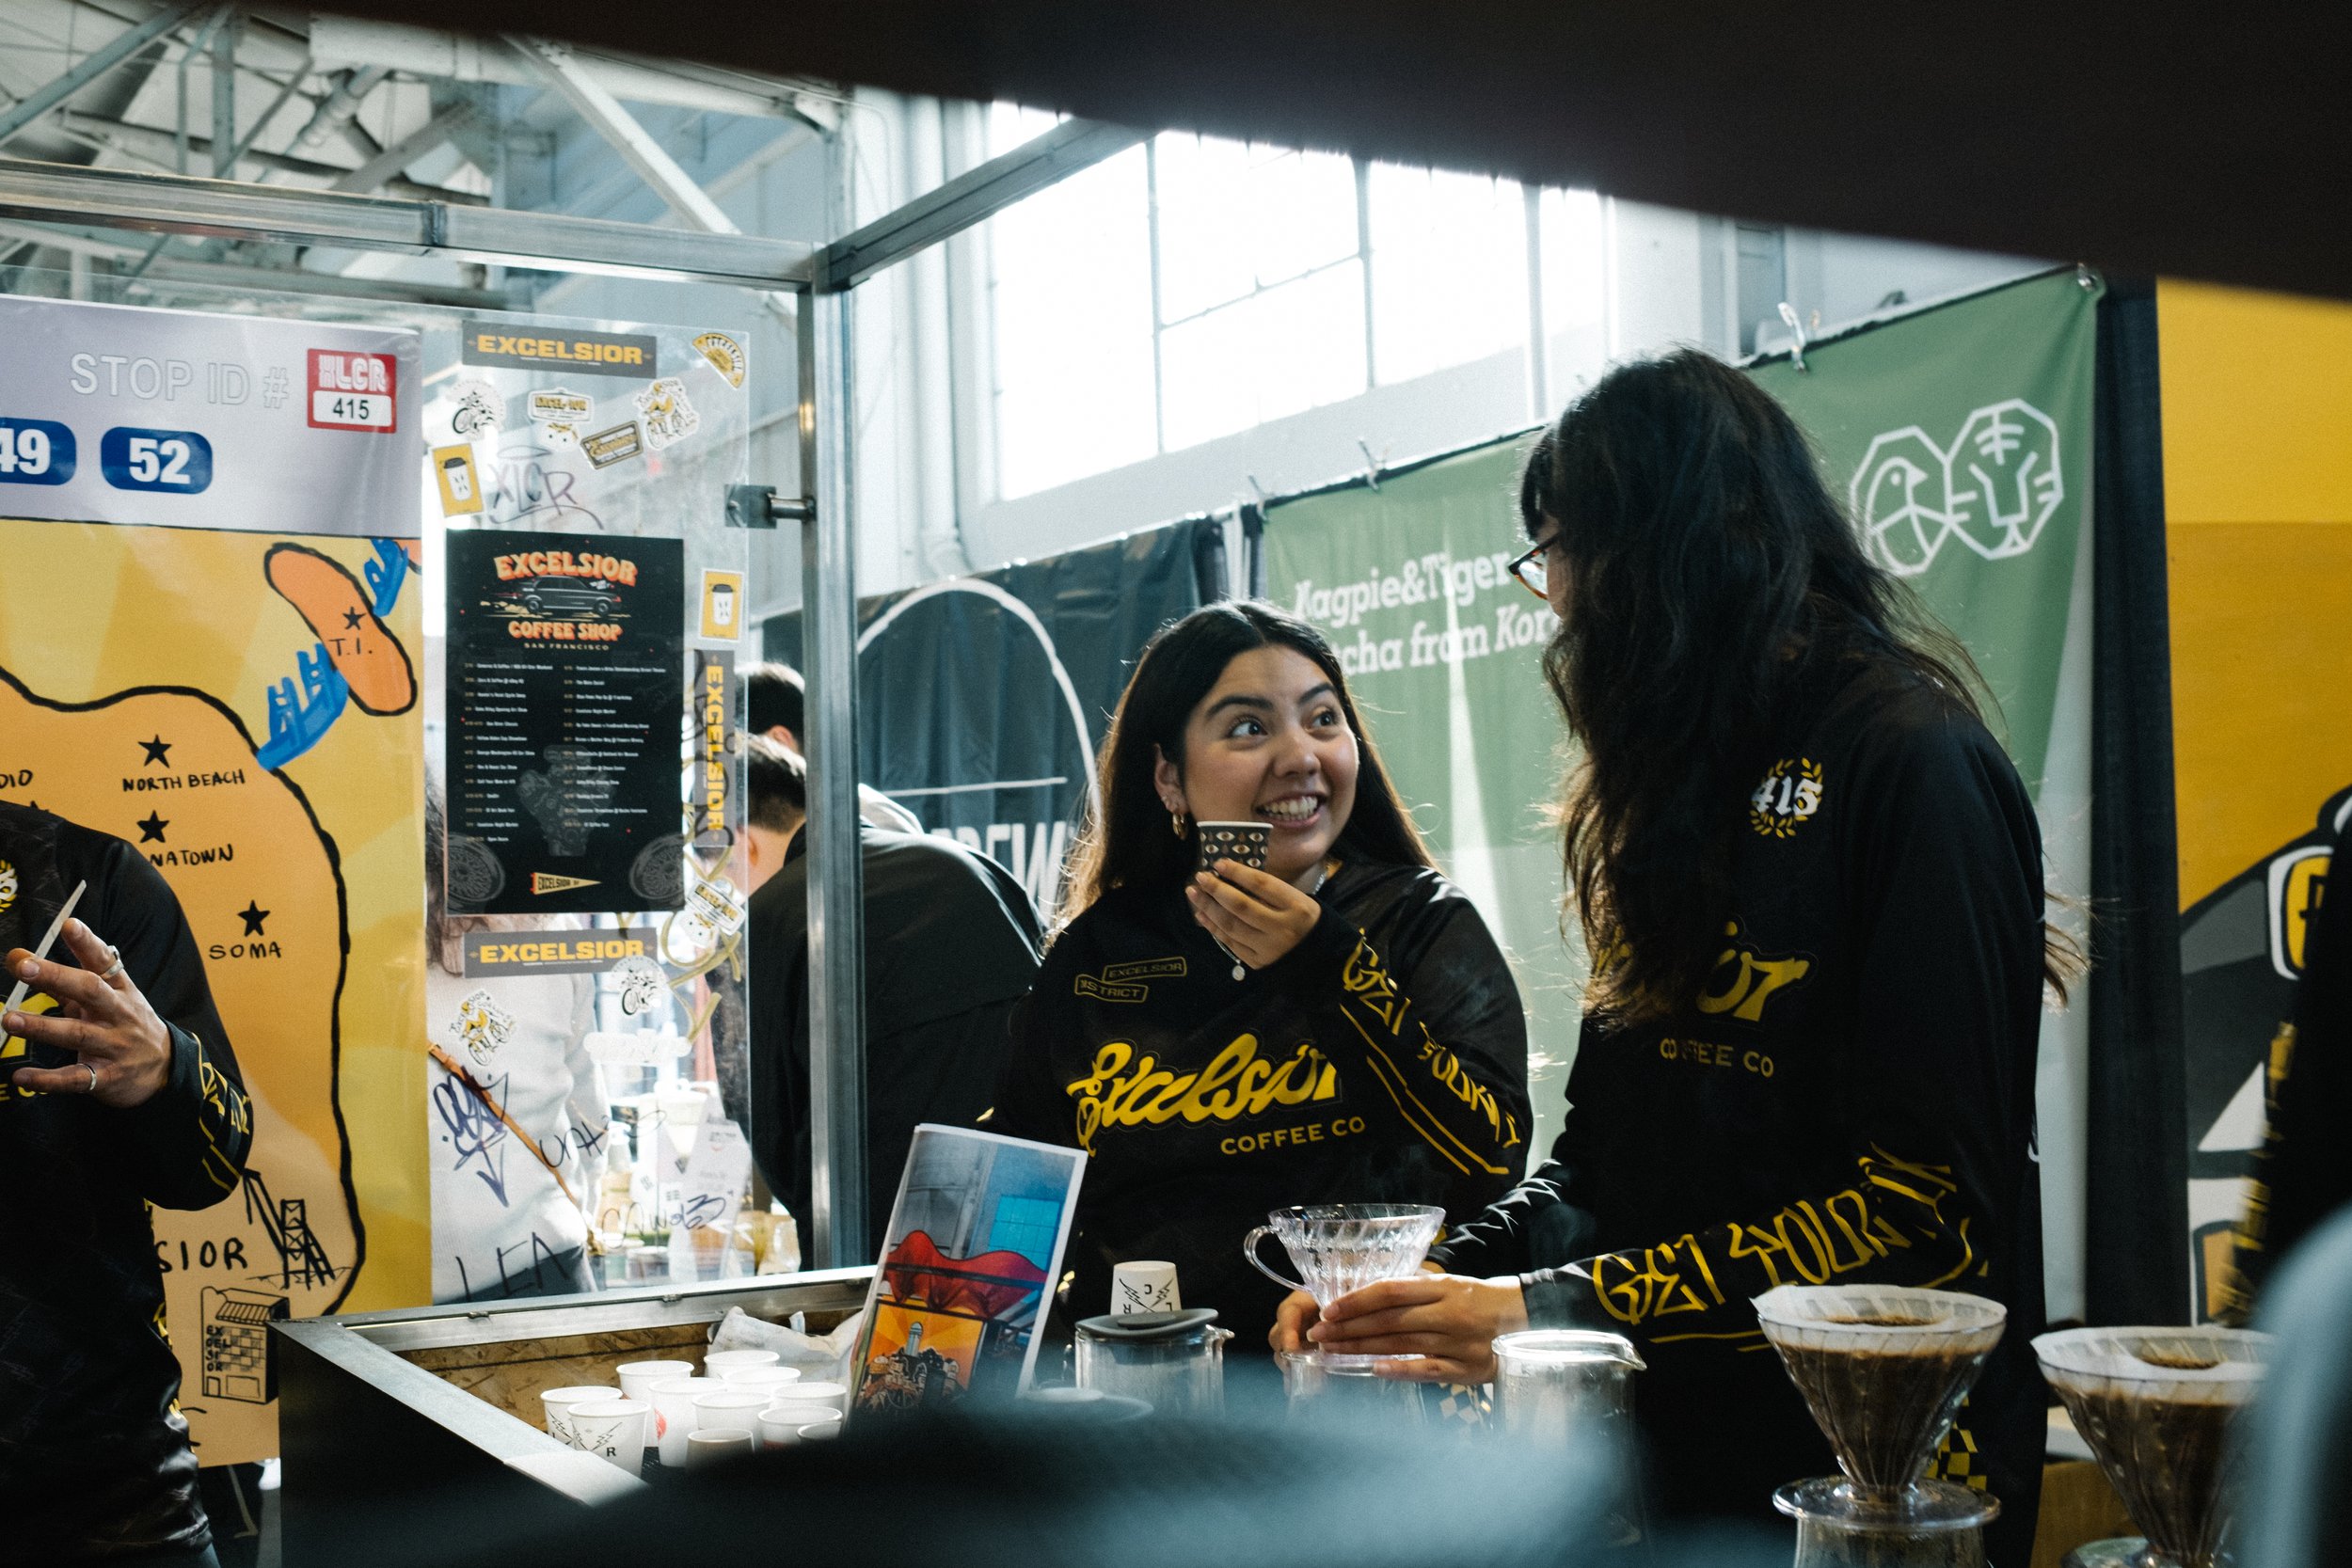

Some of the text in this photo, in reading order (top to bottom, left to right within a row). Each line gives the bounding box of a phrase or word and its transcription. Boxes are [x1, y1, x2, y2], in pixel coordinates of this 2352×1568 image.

[477, 334, 644, 365] EXCELSIOR
[70, 352, 290, 409] STOP ID #
[332, 396, 371, 420] 415
[128, 437, 191, 484] 52
[493, 550, 639, 587] EXCELSIOR
[507, 620, 624, 642] COFFEE SHOP
[1408, 621, 1491, 668] from
[548, 643, 611, 652] FRANCISCO
[706, 665, 725, 831] EXCELSIOR
[122, 768, 246, 792] NORTH BEACH
[1751, 775, 1823, 816] 415
[209, 942, 282, 959] SOMA
[479, 940, 644, 964] EXCELSIOR
[1108, 962, 1183, 978] EXCELSIOR
[1742, 1050, 1774, 1078] CO
[1220, 1116, 1366, 1155] COFFEE CO
